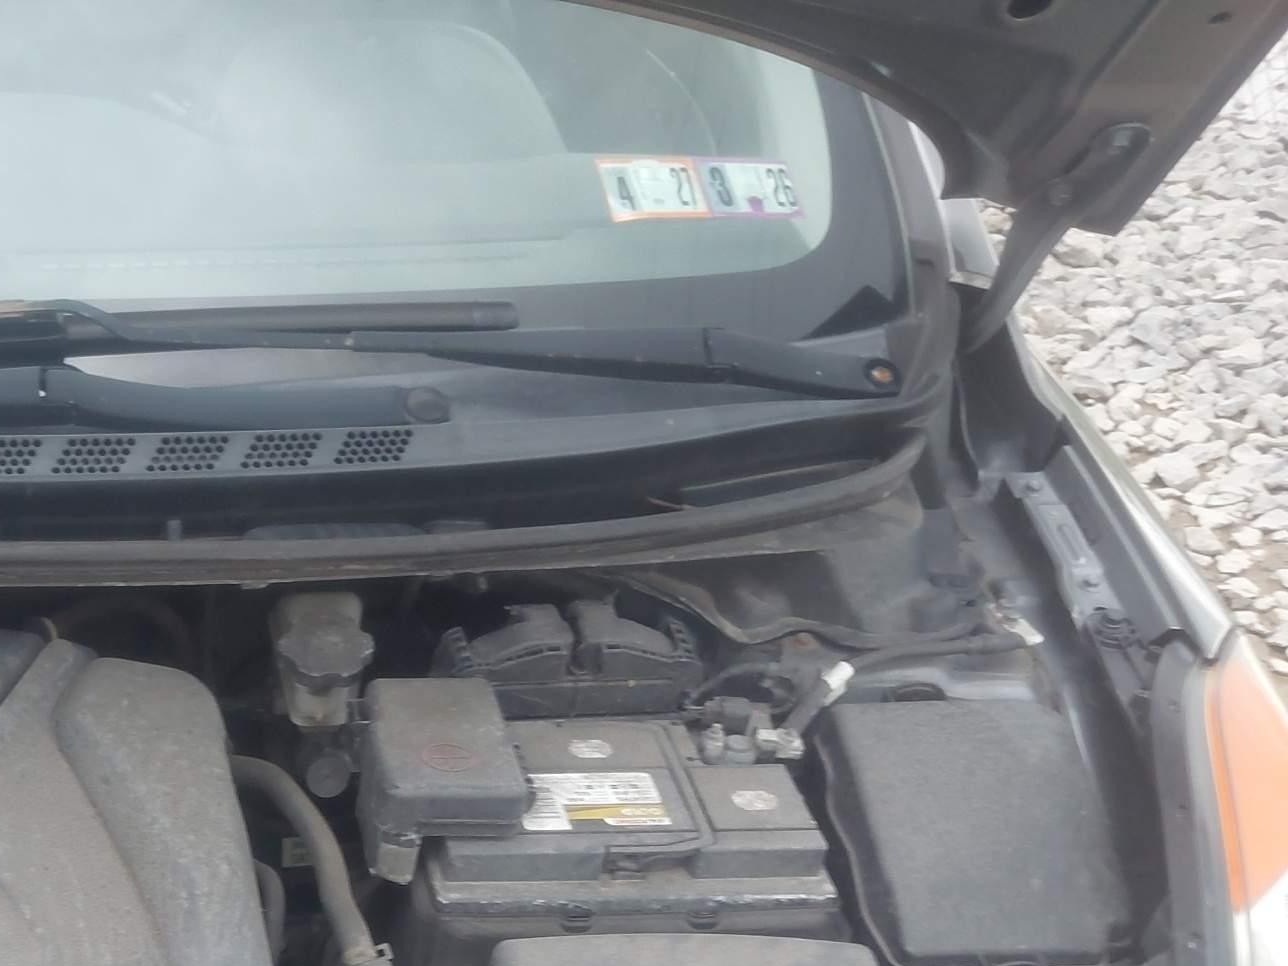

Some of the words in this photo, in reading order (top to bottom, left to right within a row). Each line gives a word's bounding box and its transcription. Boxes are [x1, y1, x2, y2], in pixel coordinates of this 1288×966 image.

[616, 176, 637, 211] 4
[669, 166, 698, 209] 27
[765, 167, 799, 207] 26
